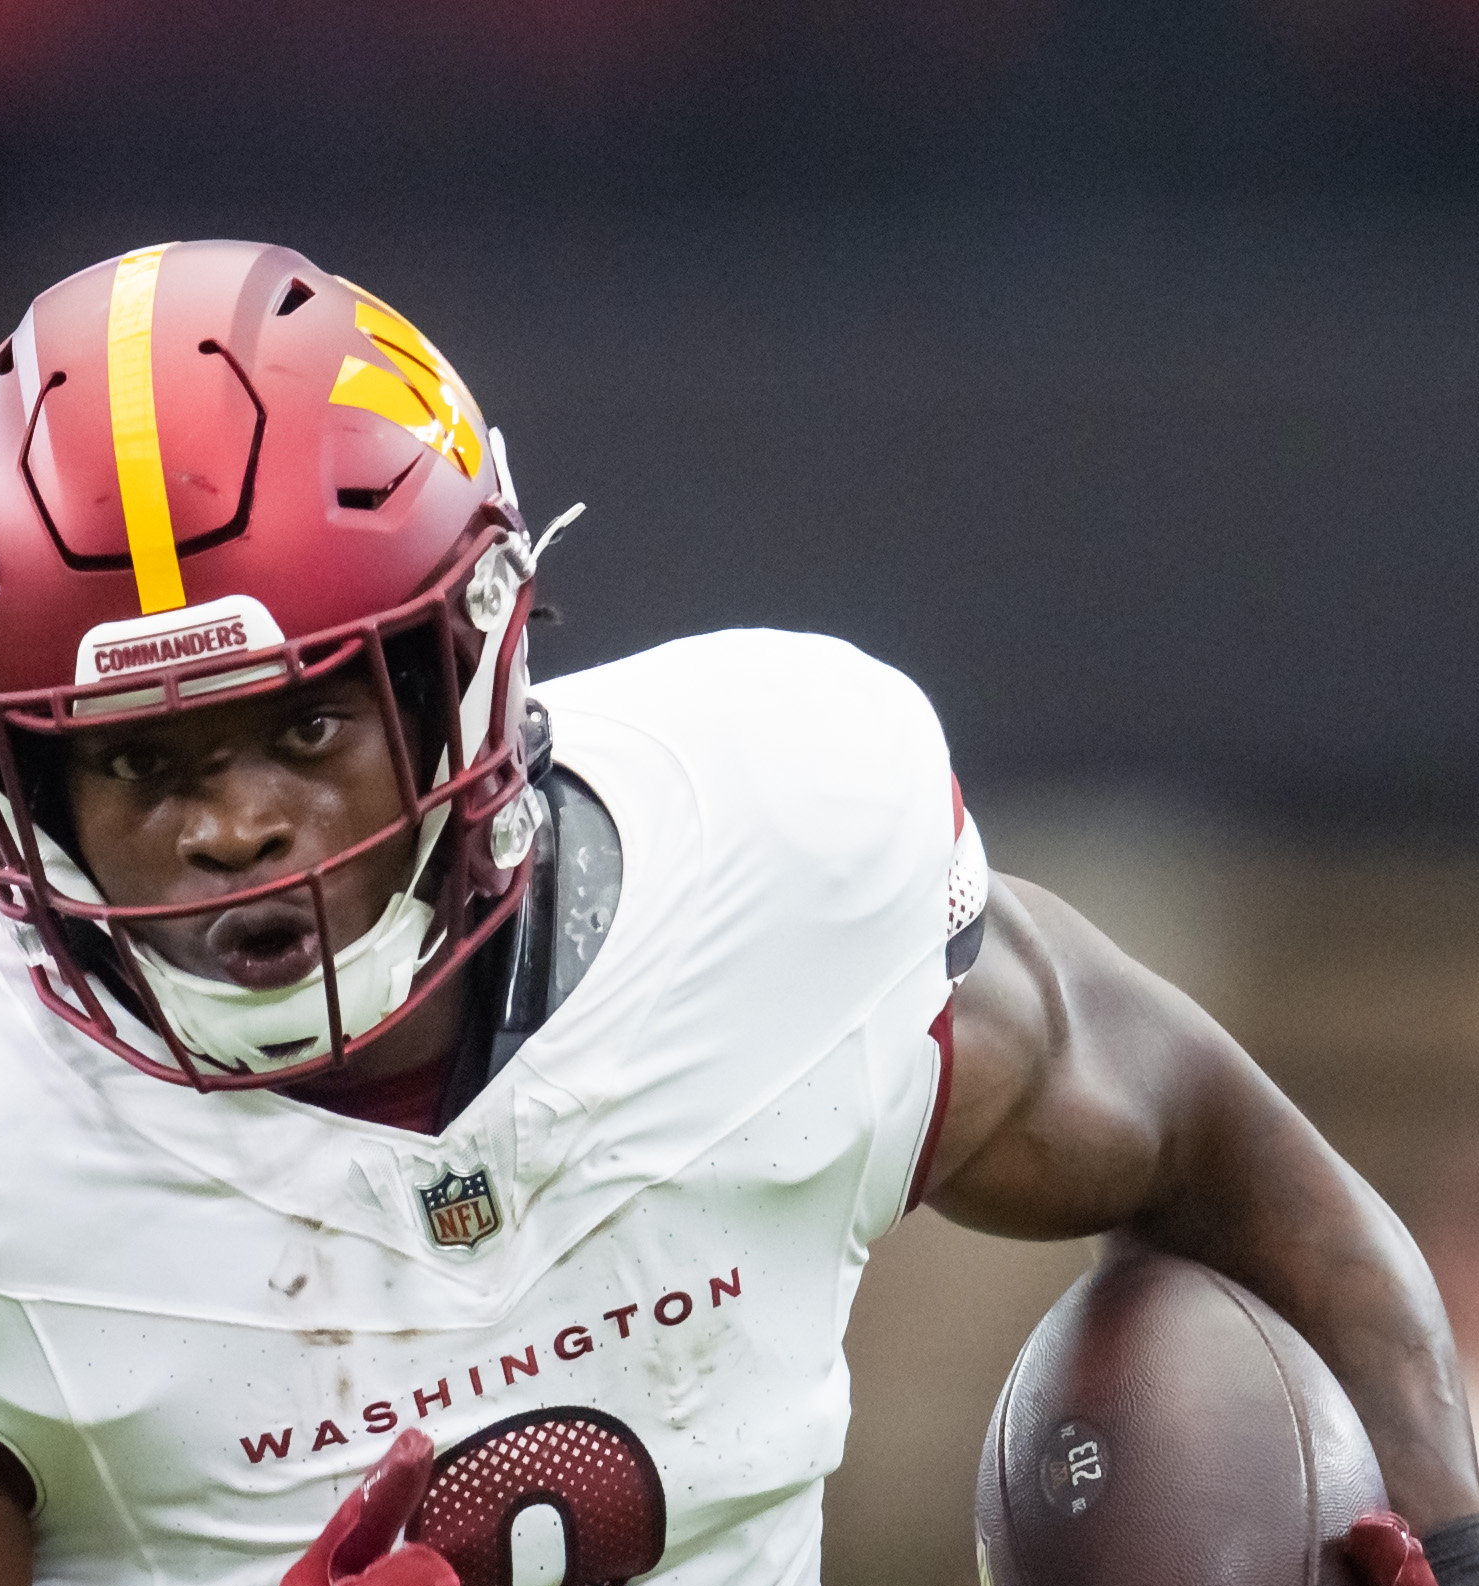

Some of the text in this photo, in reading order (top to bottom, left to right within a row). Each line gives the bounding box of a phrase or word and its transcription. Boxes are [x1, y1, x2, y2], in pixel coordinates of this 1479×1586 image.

[95, 621, 248, 674] COMMANDERS
[435, 1200, 492, 1239] NFL
[240, 1267, 742, 1464] WASHINGTON
[1068, 1440, 1102, 1487] 213
